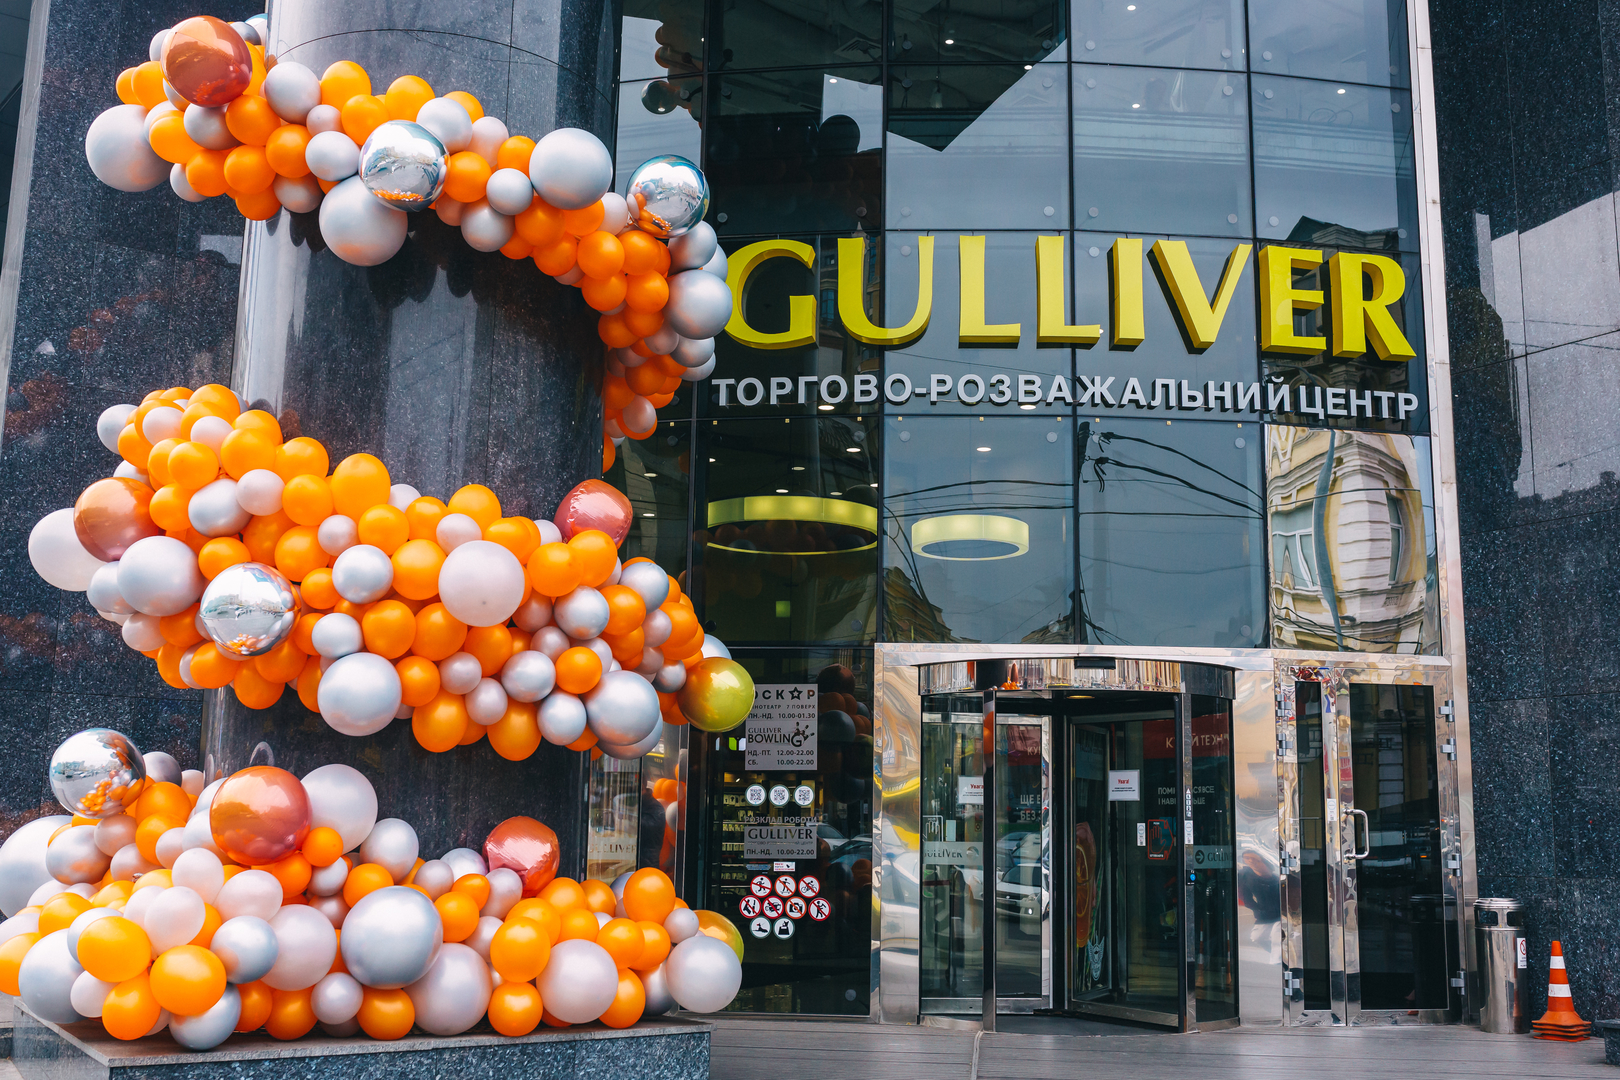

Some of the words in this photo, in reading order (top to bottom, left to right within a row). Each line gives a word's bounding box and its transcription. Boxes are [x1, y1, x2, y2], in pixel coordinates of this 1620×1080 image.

[725, 235, 1416, 363] GULLIVER
[711, 373, 1292, 413] ТОРГОВО-РОЗВАЖАЛЬНИЙ
[1299, 385, 1419, 420] ЦЕНТР
[748, 733, 803, 747] BOWLING
[1020, 795, 1034, 805] ЩЕ
[1020, 811, 1036, 820] БЕЗ
[748, 828, 813, 839] GULLIVER
